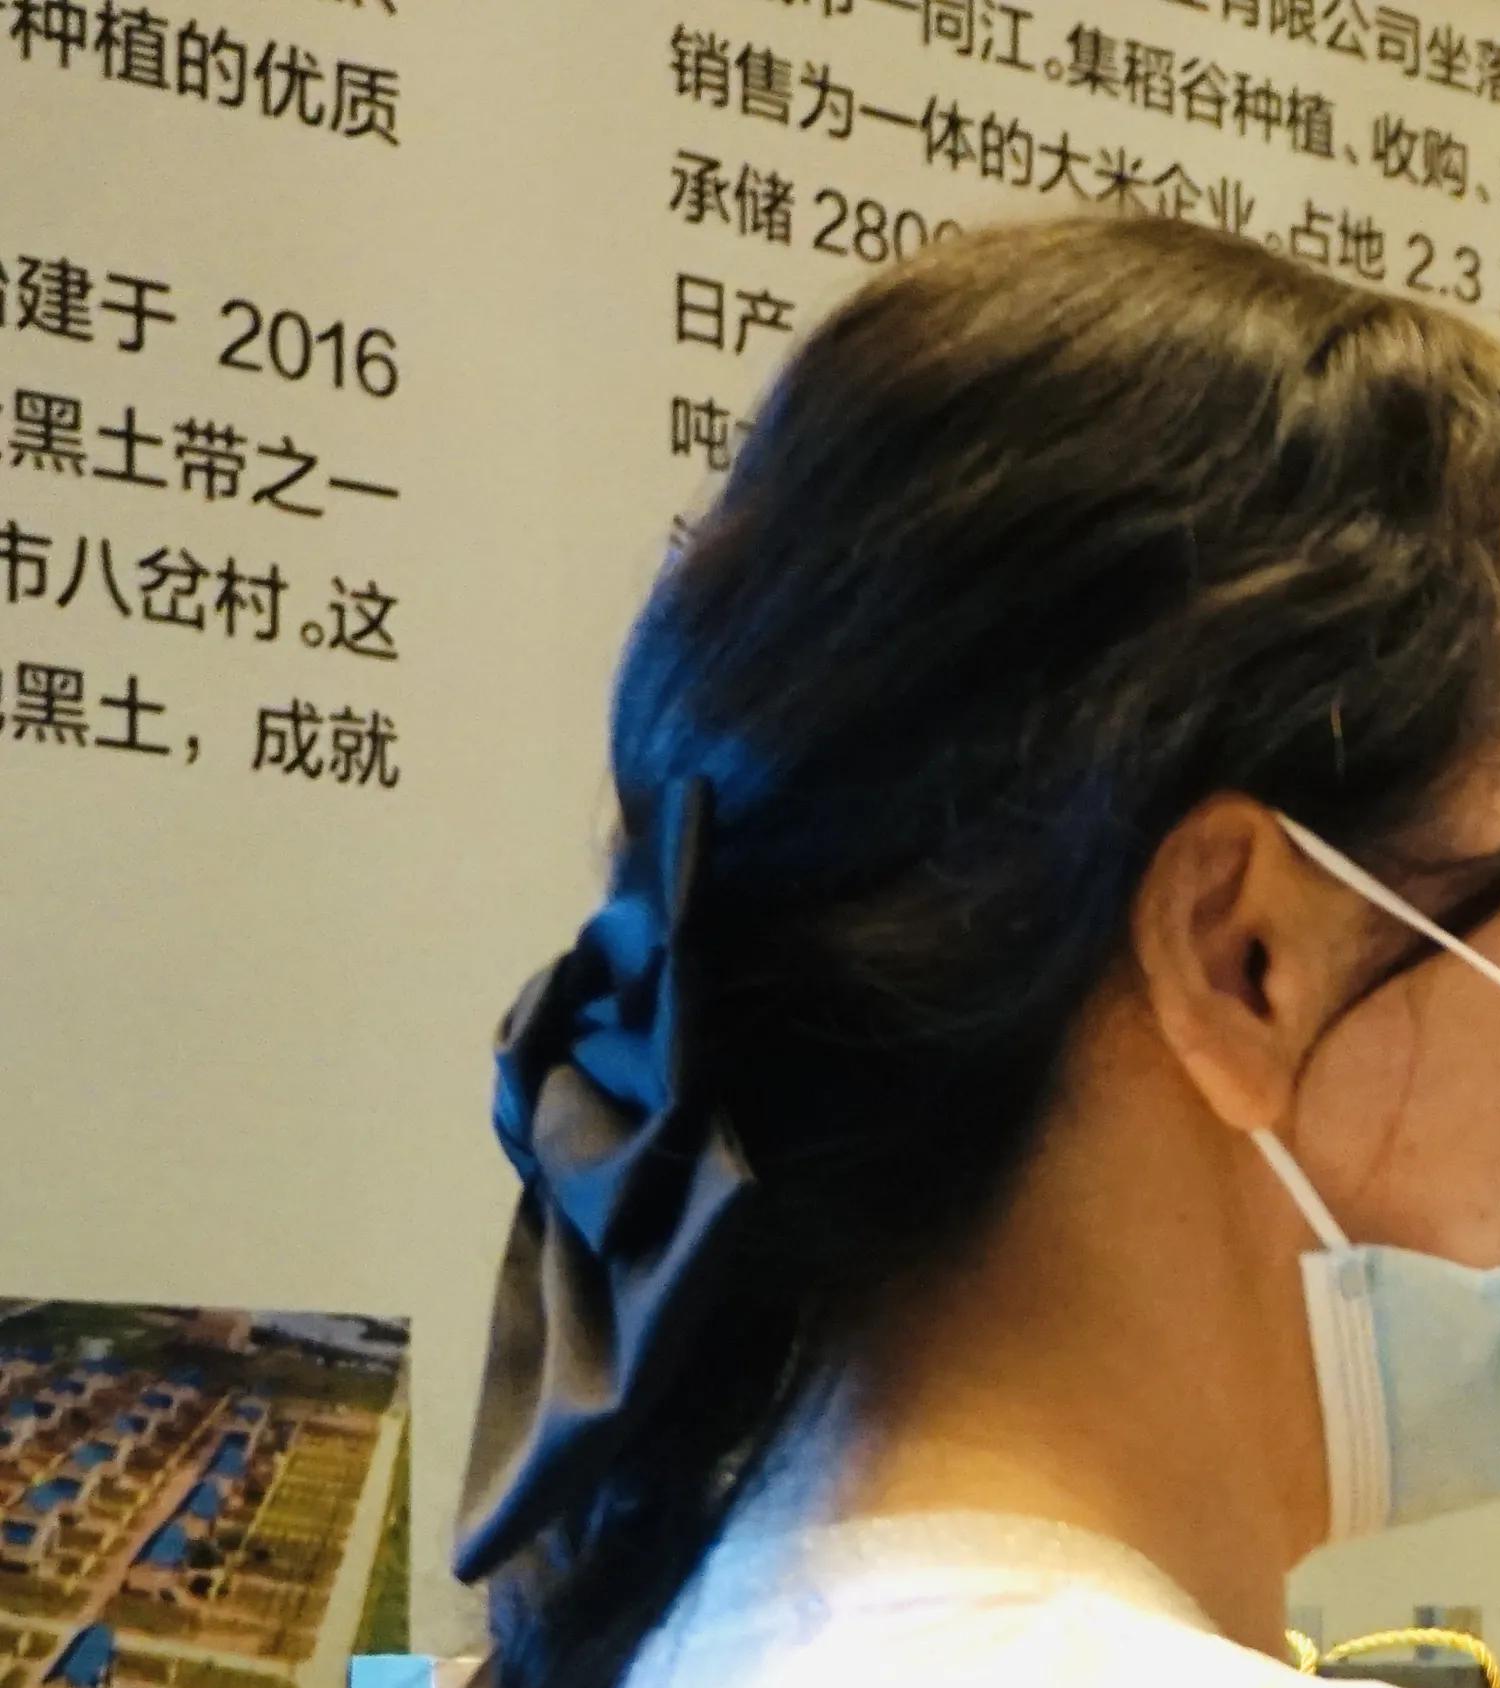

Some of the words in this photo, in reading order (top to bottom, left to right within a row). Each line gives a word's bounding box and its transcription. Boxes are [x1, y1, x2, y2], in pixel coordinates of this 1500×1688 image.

[668, 150, 795, 247] 承储
[676, 272, 795, 355] 日产
[1406, 232, 1482, 303] 2.3
[0, 255, 176, 353] 建于
[218, 298, 398, 398] 2016
[0, 388, 399, 518] 黑土带之一
[0, 660, 398, 788] 黑土，成就
